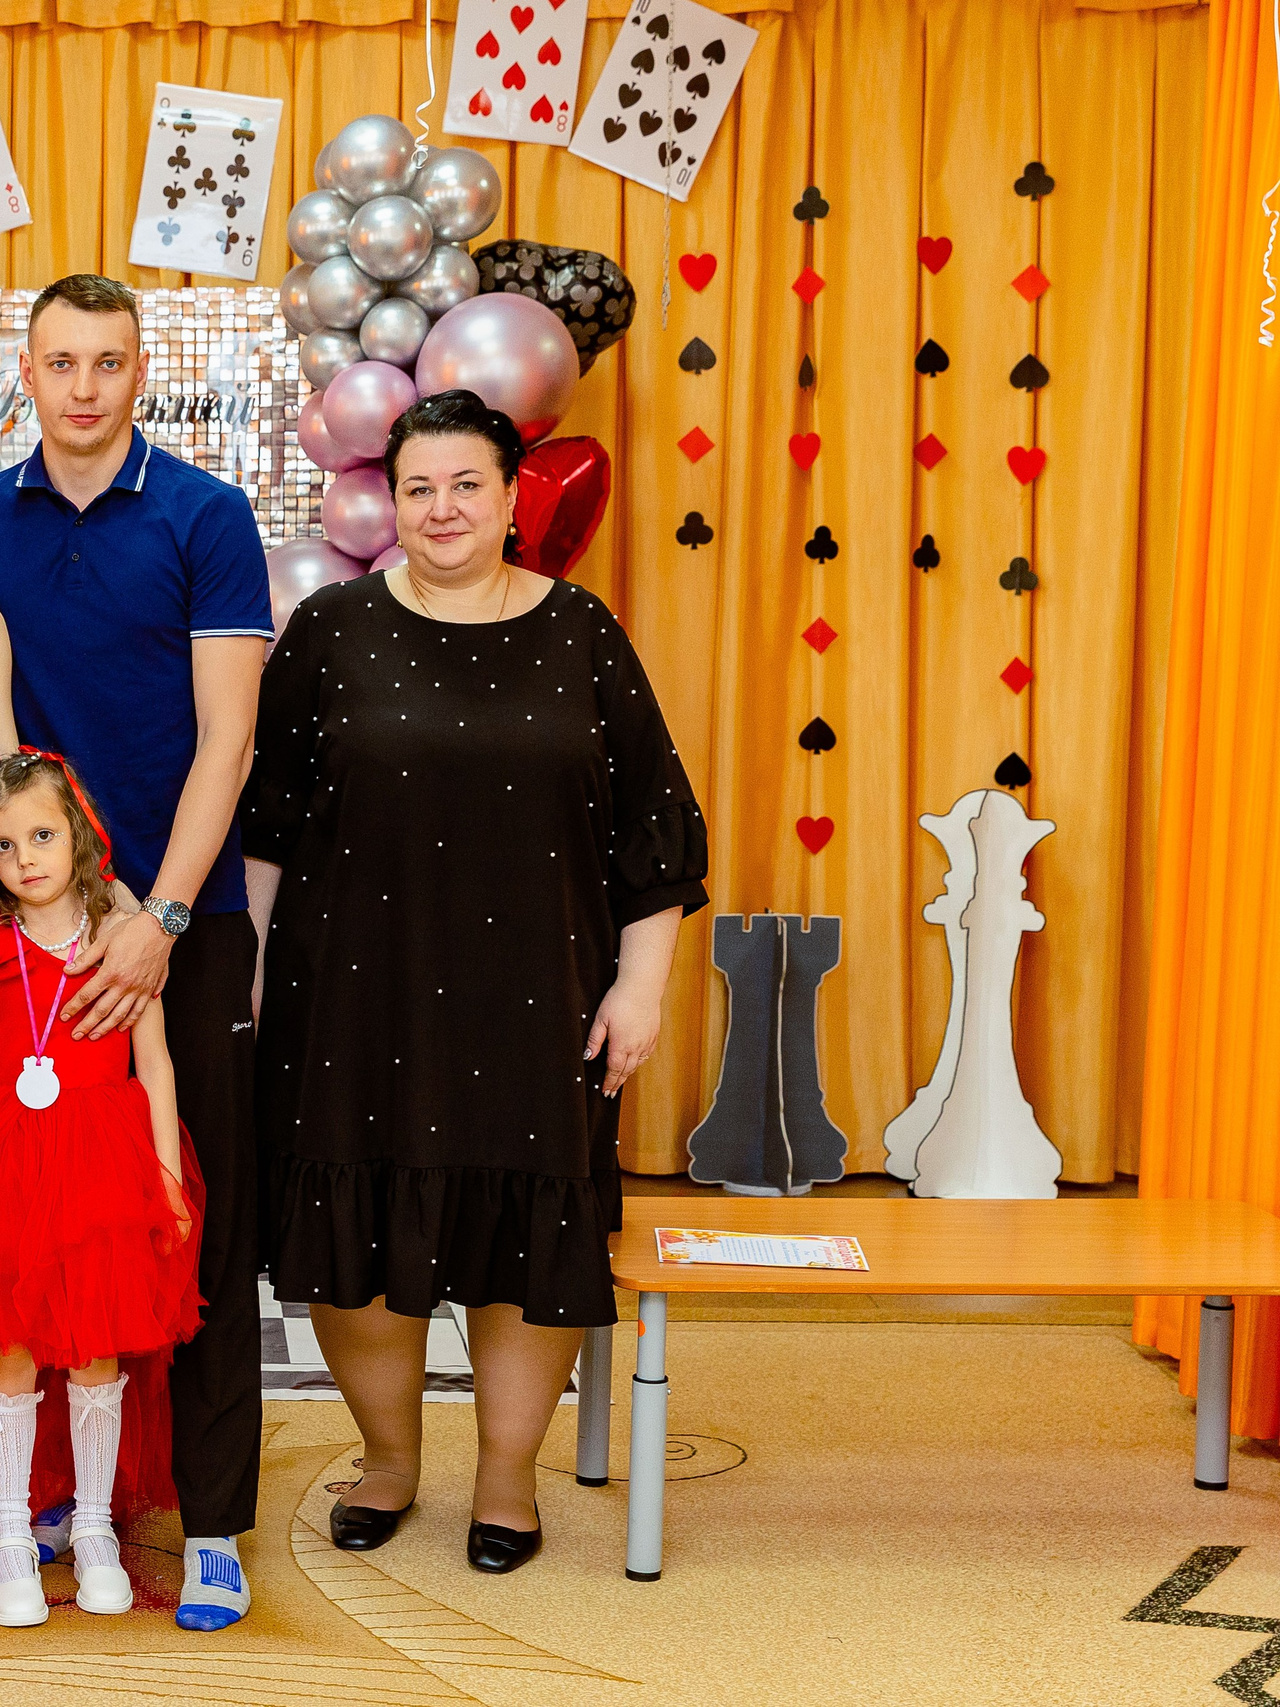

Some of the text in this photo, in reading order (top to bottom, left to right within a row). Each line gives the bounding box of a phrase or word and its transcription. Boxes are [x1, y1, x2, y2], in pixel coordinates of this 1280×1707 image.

[556, 114, 568, 132] 8
[676, 167, 692, 187] 10
[8, 196, 20, 213] 8
